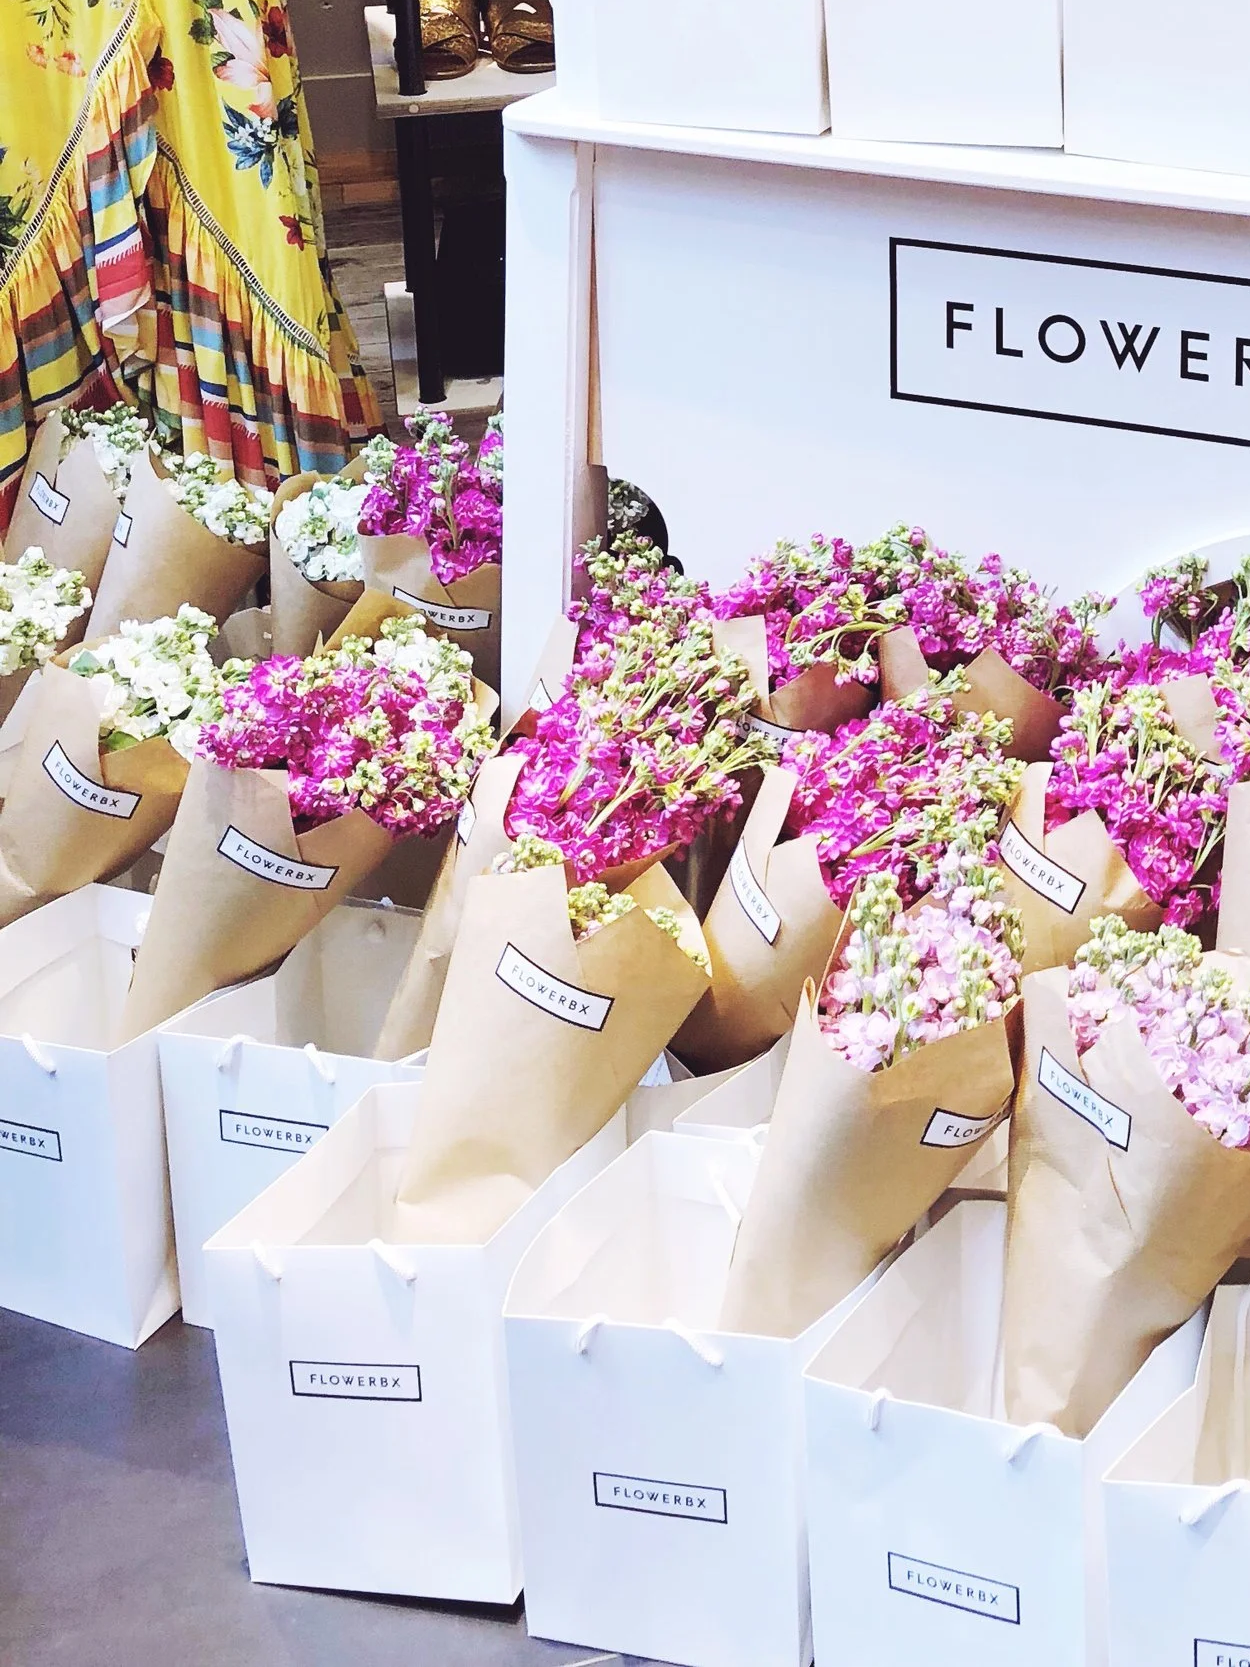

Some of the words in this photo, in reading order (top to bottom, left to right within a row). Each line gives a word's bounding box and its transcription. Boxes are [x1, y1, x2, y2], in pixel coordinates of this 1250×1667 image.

[54, 761, 121, 809] FLOWERBX
[236, 843, 316, 884] FLOWERBX
[1004, 837, 1066, 894] FLOWERBX
[511, 964, 591, 1016] FLOWERBX
[1049, 1069, 1114, 1129] FLOWERBX
[0, 1130, 46, 1150] WERBX
[235, 1123, 314, 1145] FLOWERBX
[943, 1124, 984, 1138] FLOW
[309, 1373, 401, 1389] FLOWERBX
[613, 1486, 706, 1509] FLOWERBX
[906, 1569, 1000, 1606] FLOWERBX
